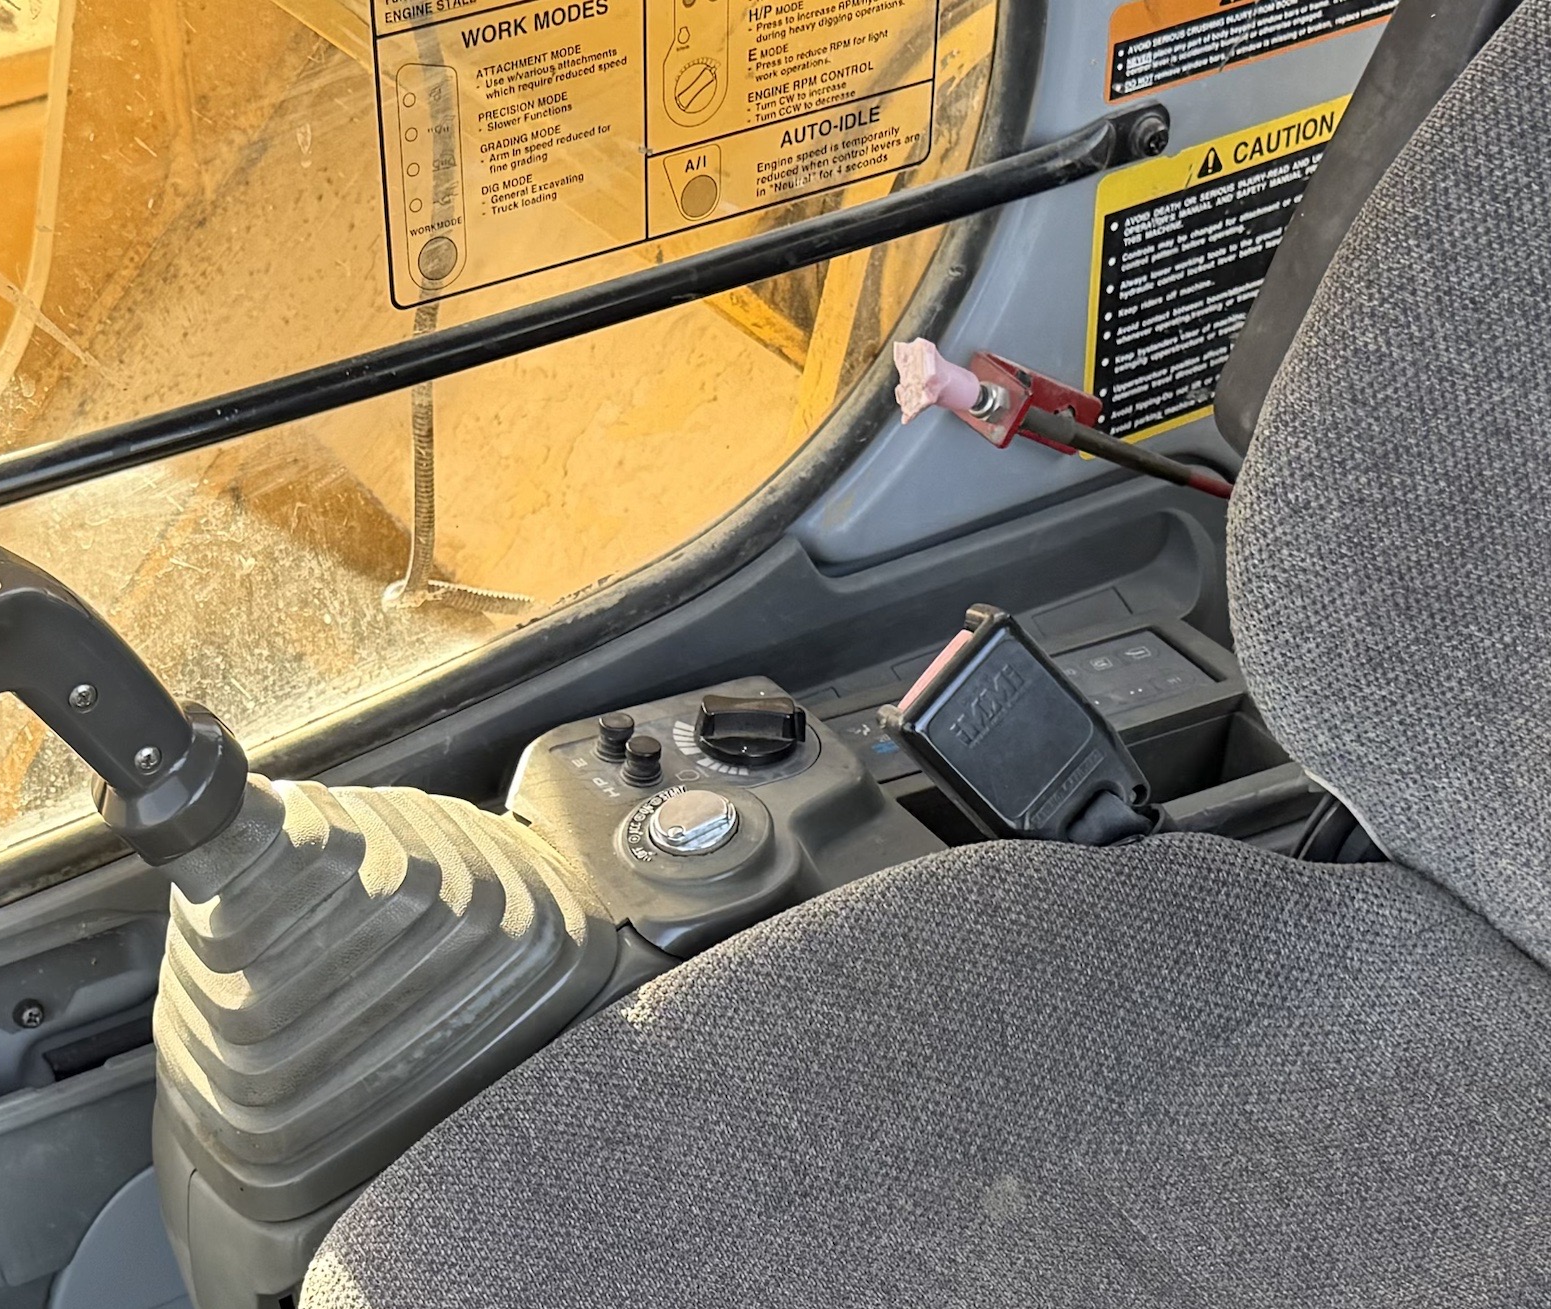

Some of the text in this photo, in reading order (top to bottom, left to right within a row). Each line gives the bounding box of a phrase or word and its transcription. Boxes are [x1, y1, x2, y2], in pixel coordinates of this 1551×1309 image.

[384, 2, 433, 23] ENGINE
[461, 0, 609, 48] WORK MODES
[748, 1, 804, 22] H/P MODE
[755, 19, 783, 32] Press
[785, 16, 795, 24] to
[797, 6, 837, 22] increase
[755, 30, 787, 43] during
[788, 22, 817, 34] heavy
[817, 12, 853, 27] digging
[476, 44, 582, 79] ATTACHMENT MODE
[747, 44, 789, 62] E MODE
[755, 30, 889, 71] Press to reduce RPM for light
[485, 49, 618, 88] Use w/various attachments
[485, 56, 628, 99] which require reduced speed
[747, 61, 875, 103] ENGINE RPM CONTROL
[755, 70, 778, 82] work
[477, 92, 569, 122] PRECISION MODE
[755, 100, 777, 111] Turn
[778, 94, 795, 105] CW
[808, 82, 847, 97] increase
[755, 90, 856, 122] Turn CCW to decrease
[487, 104, 573, 131] Slower Functions
[780, 105, 881, 148] AUTO-IDLE
[479, 125, 561, 153] GRADING MODE
[489, 152, 510, 162] Arm
[523, 138, 554, 154] speed
[555, 127, 596, 144] reduced
[597, 125, 611, 134] for
[757, 127, 900, 172] Engine speed is temporarily
[1233, 111, 1335, 164] CAUTION
[489, 153, 548, 174] fine grading
[684, 155, 707, 172] A/I
[756, 134, 921, 185] reduced when control levers are
[819, 170, 833, 179] for
[836, 165, 843, 174] 4
[844, 154, 889, 172] seconds
[481, 174, 533, 195] DIG MODE
[490, 174, 585, 204] General Excavating
[491, 192, 557, 214] Truck loading
